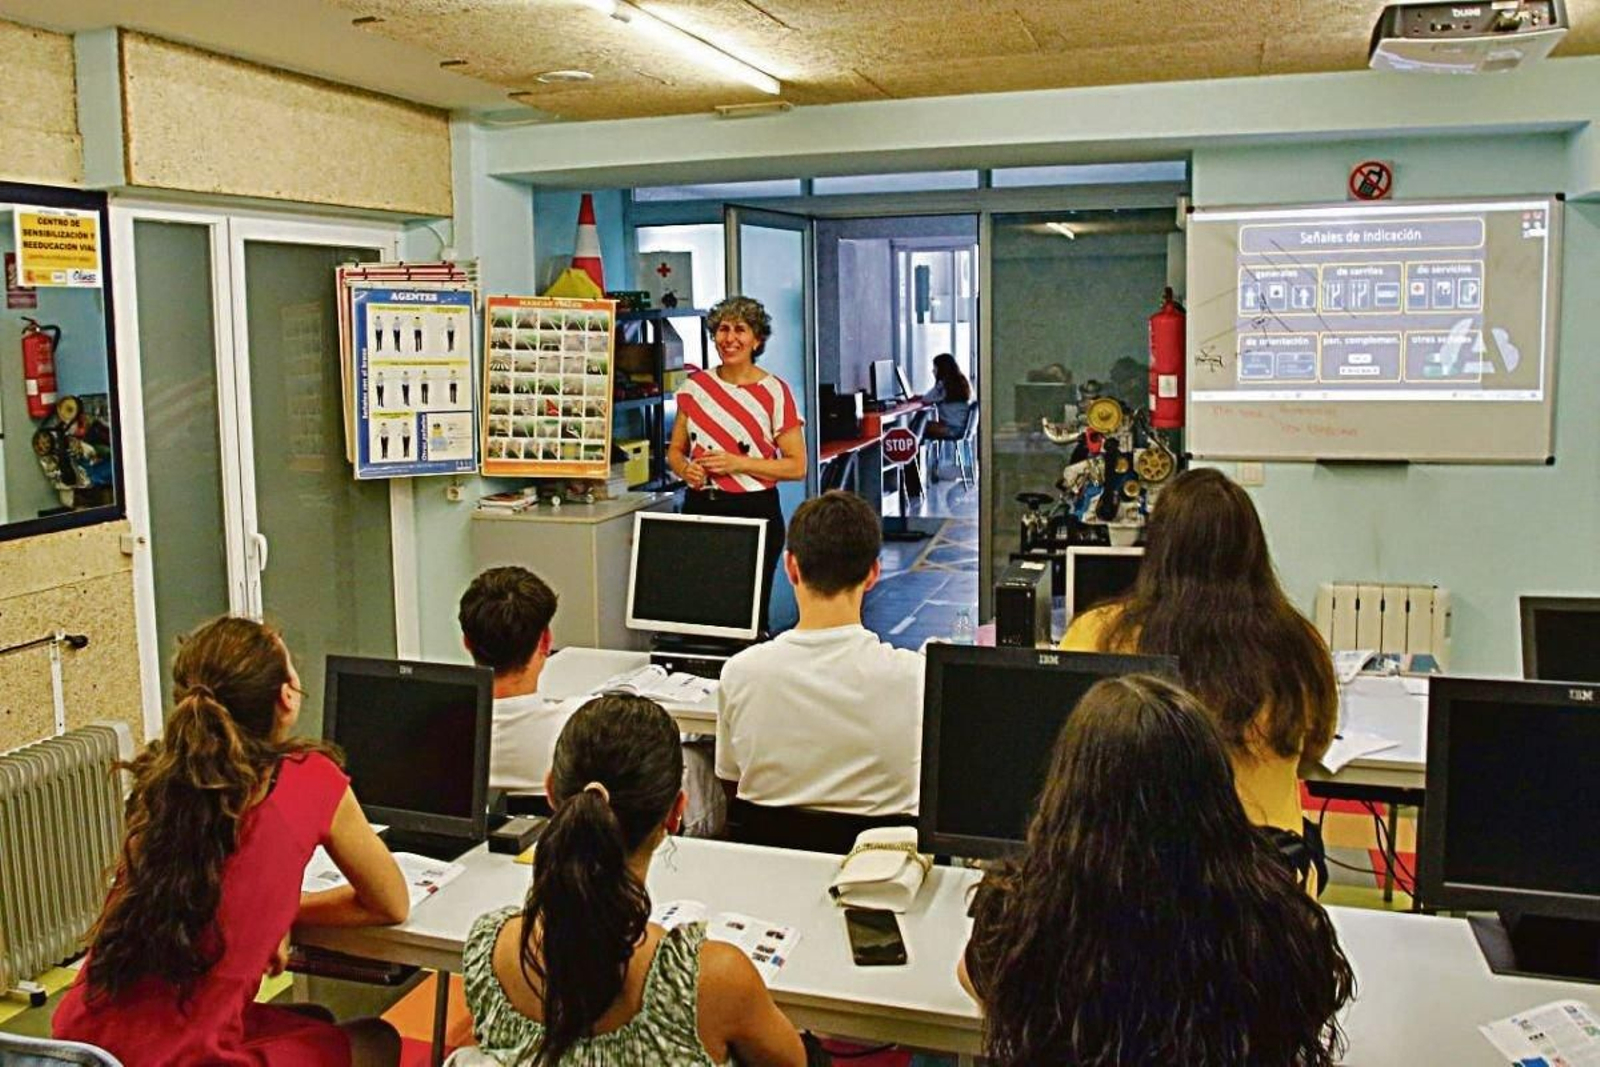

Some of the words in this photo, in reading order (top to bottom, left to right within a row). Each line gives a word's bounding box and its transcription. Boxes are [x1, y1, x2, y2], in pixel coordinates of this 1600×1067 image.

[37, 217, 69, 226] CENTRO
[70, 219, 81, 228] DE
[1300, 231, 1344, 244] Señales
[1346, 230, 1360, 243] de
[79, 243, 96, 252] VIAL
[1417, 265, 1429, 274] de
[1432, 265, 1472, 274] servicios
[390, 292, 438, 302] AGENTES
[885, 438, 914, 452] STOP
[1039, 654, 1059, 666] IBM
[1569, 689, 1594, 701] IBM
